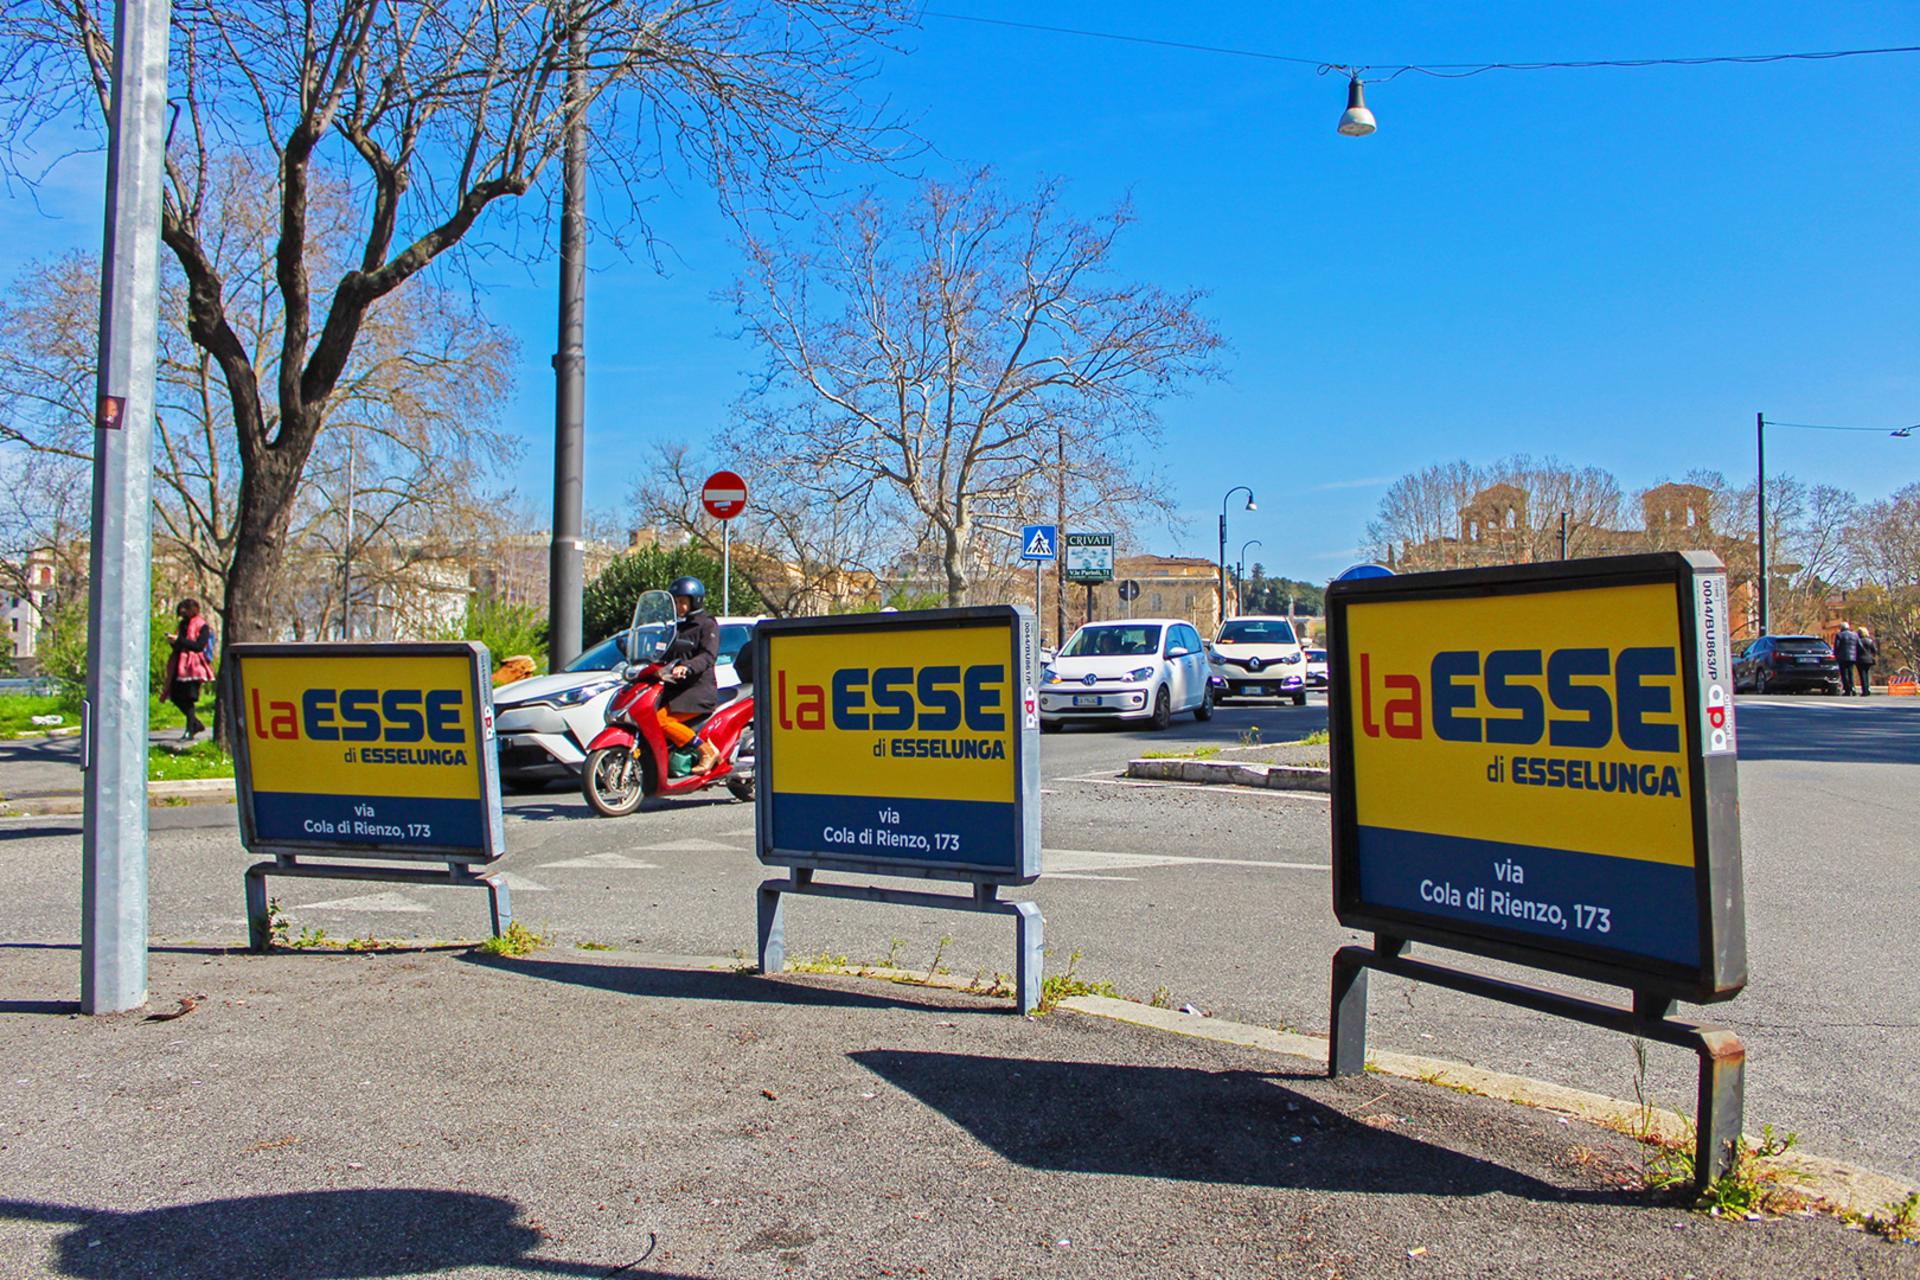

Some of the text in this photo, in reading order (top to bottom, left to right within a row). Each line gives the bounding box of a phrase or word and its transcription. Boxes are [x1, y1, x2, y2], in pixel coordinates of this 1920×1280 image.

[344, 748, 467, 766] di ESSELUNGA
[873, 738, 1005, 760] di ESSELUNGA
[1486, 755, 1681, 798] di ESSELUNGA
[354, 803, 375, 817] via
[878, 807, 900, 824] via
[304, 819, 431, 839] Cola di Rienzo, 173
[823, 827, 960, 852] Cola di Rienzo, 173
[1494, 858, 1524, 884] via
[1420, 879, 1612, 933] Cola di Rienzo, 173
